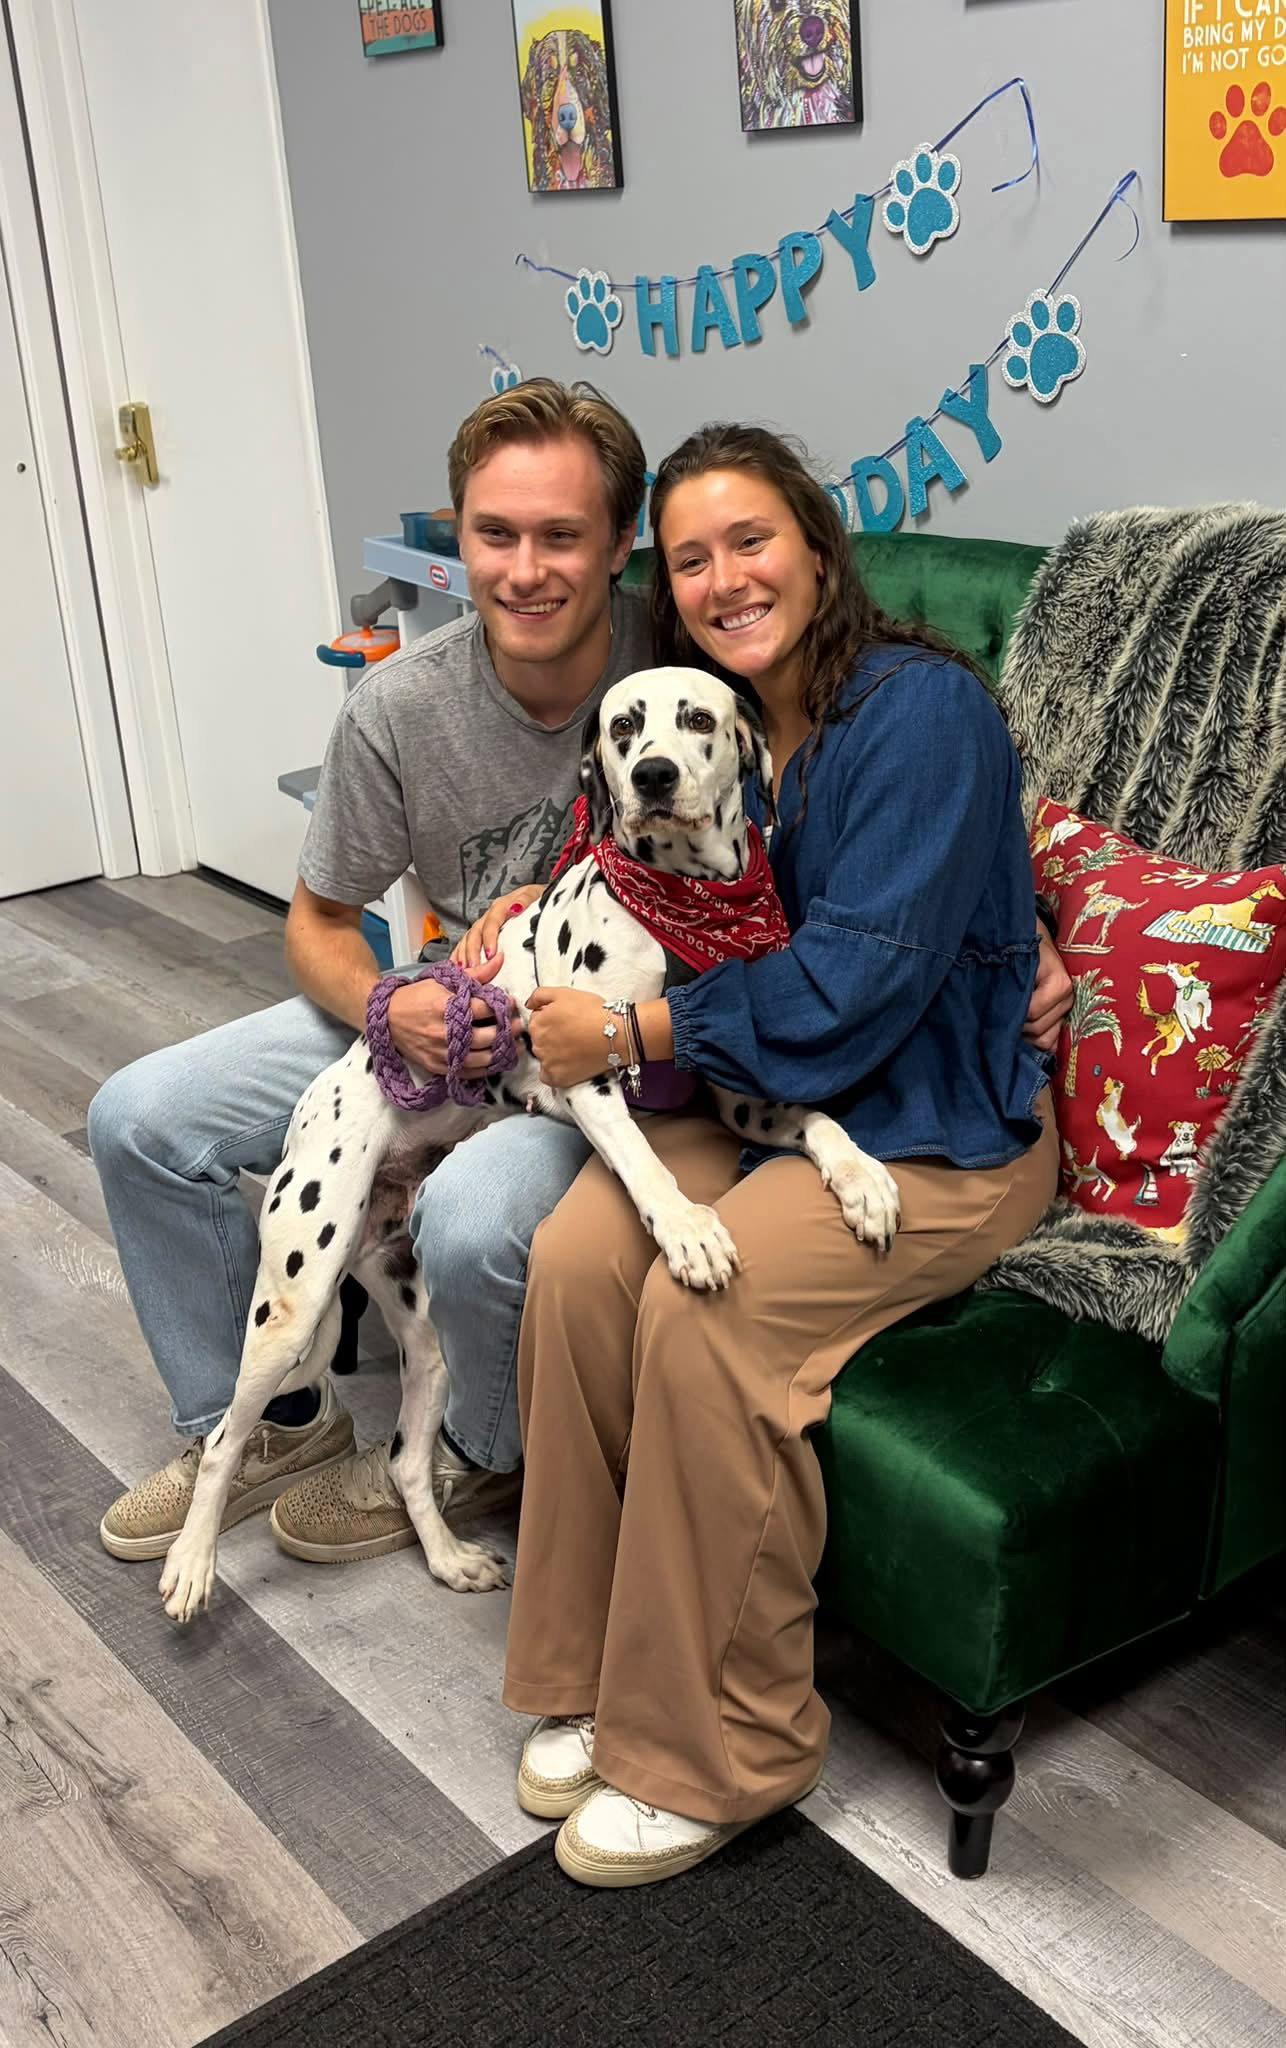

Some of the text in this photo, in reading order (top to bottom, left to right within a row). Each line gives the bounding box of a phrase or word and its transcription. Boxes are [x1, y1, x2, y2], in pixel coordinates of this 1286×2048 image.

[369, 10, 427, 38] THE DOGS
[1183, 21, 1234, 49] BRING
[1241, 17, 1267, 43] MY
[1182, 50, 1204, 75] I'M
[1210, 47, 1250, 73] NOT
[635, 193, 876, 357] HAPPY
[851, 363, 1002, 533] DAY
